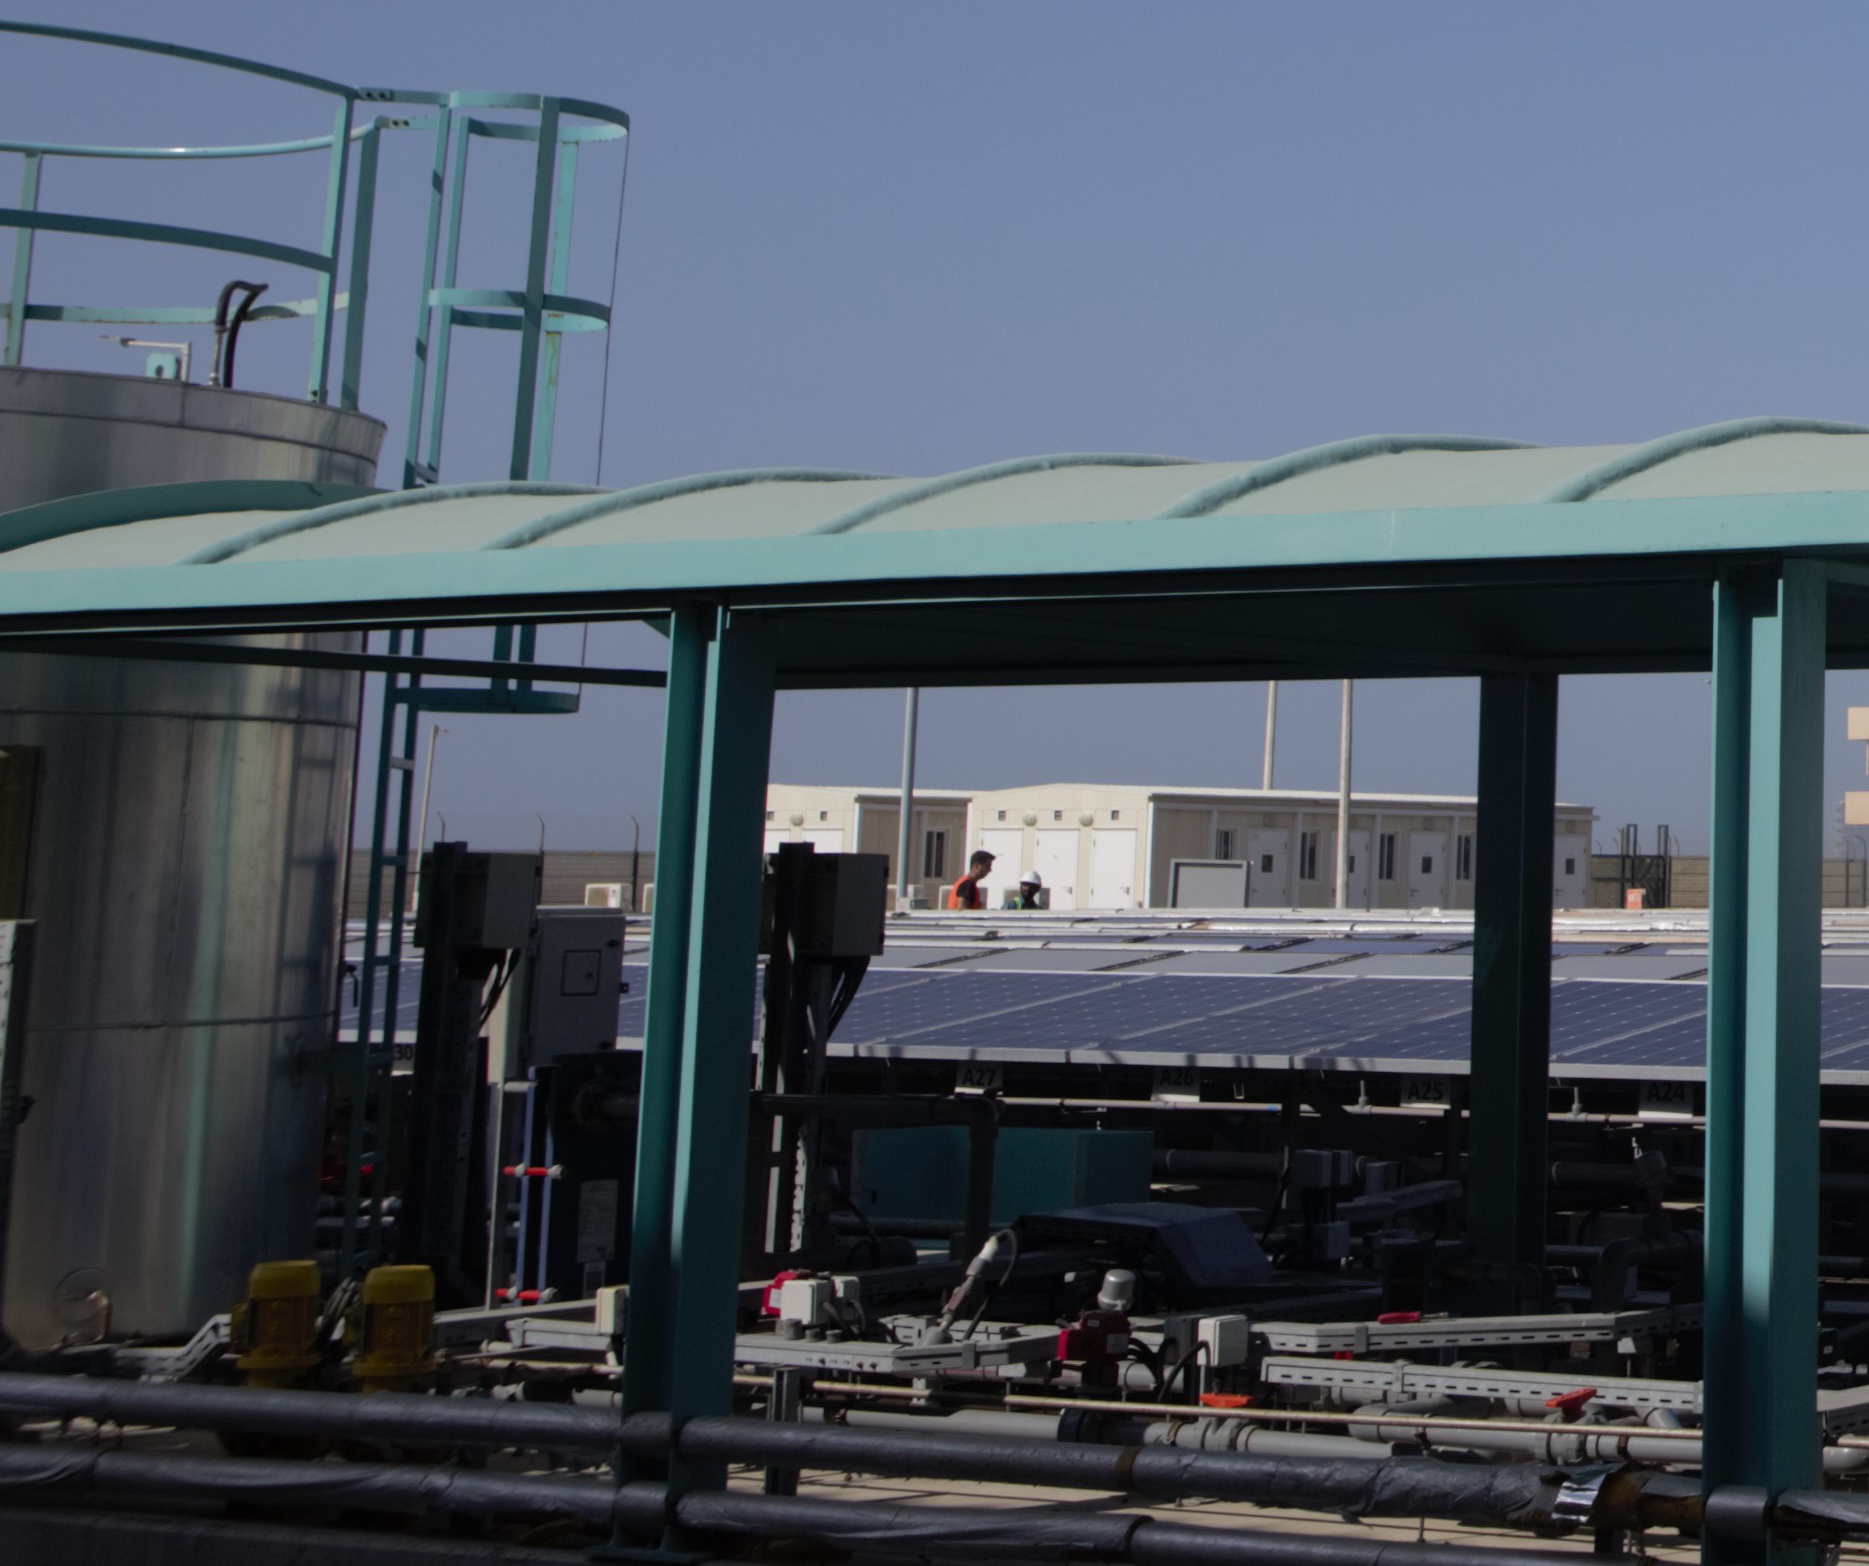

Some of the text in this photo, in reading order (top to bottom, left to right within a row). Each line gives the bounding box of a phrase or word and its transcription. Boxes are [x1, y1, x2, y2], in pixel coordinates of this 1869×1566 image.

[963, 1069, 996, 1087] A27
[1159, 1067, 1194, 1086] A26
[1407, 1082, 1443, 1101] A25
[1646, 1081, 1685, 1101] A24
